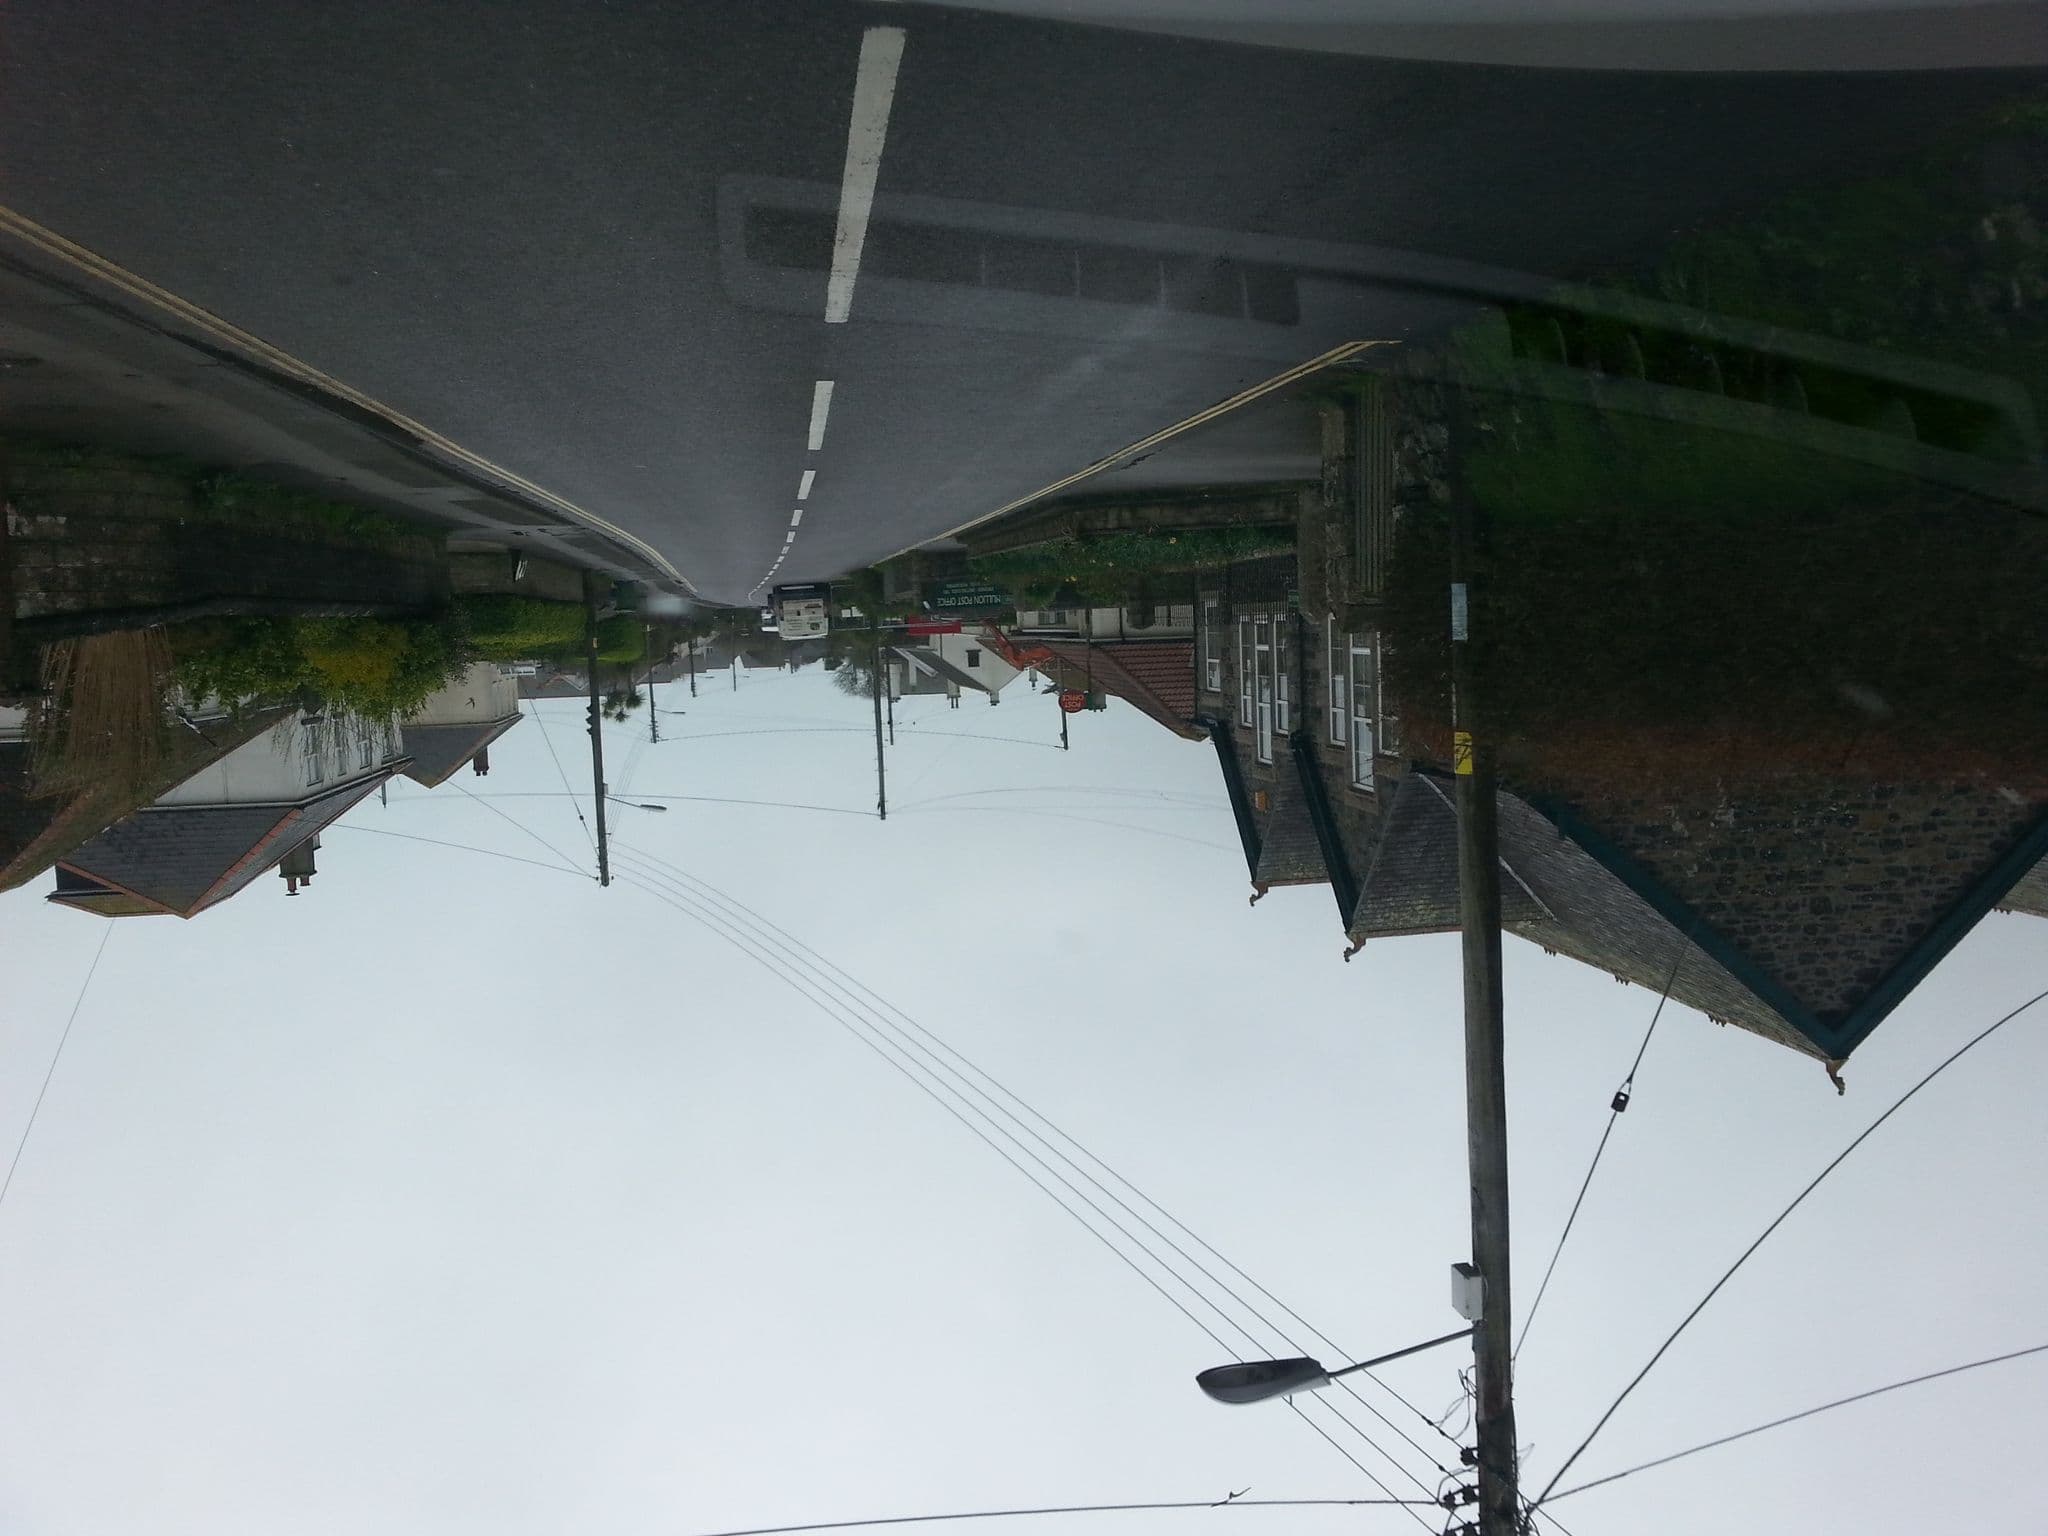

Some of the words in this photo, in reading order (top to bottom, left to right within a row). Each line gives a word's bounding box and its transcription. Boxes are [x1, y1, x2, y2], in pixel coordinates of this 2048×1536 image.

[937, 597, 956, 606] OFFICE
[957, 596, 972, 605] POST
[974, 595, 1001, 604] MULLION
